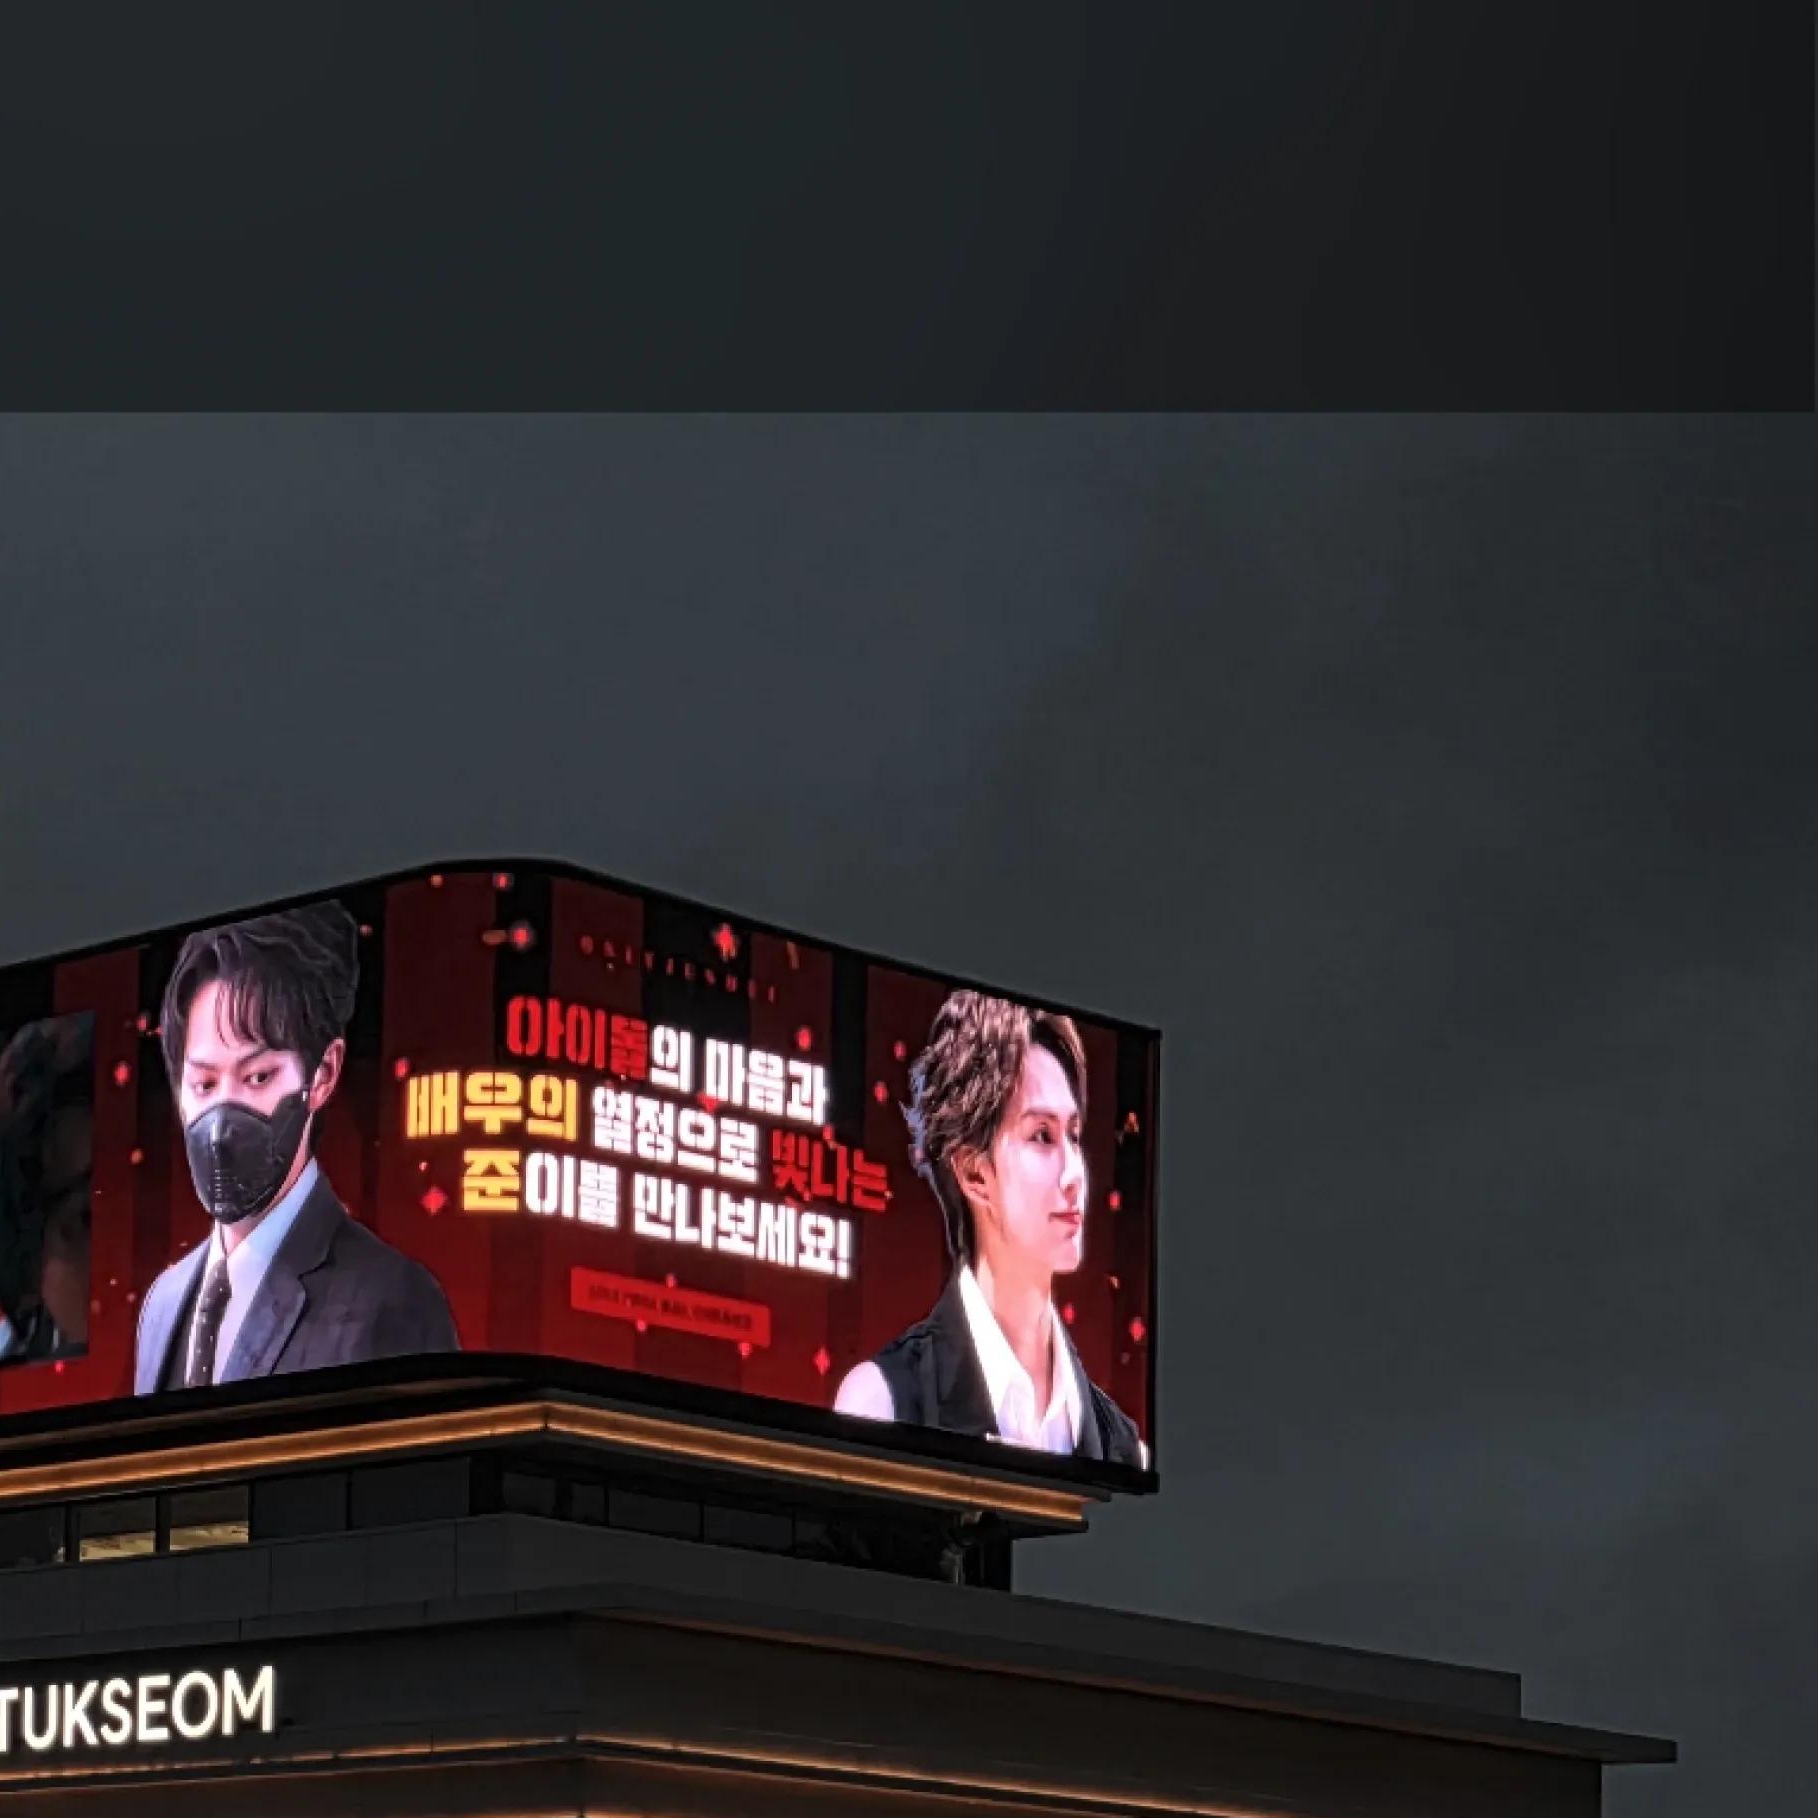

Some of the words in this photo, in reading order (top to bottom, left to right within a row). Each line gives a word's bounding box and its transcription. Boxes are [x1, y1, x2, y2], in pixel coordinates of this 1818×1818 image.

[506, 996, 691, 1092] 아이돌의
[705, 1037, 828, 1126] 마음과
[406, 1071, 578, 1142] 배우의
[592, 1085, 760, 1183] 열정으로
[771, 1128, 887, 1211] 빛나는
[462, 1149, 620, 1229] 준이를
[634, 1171, 852, 1280] 만나보세요!
